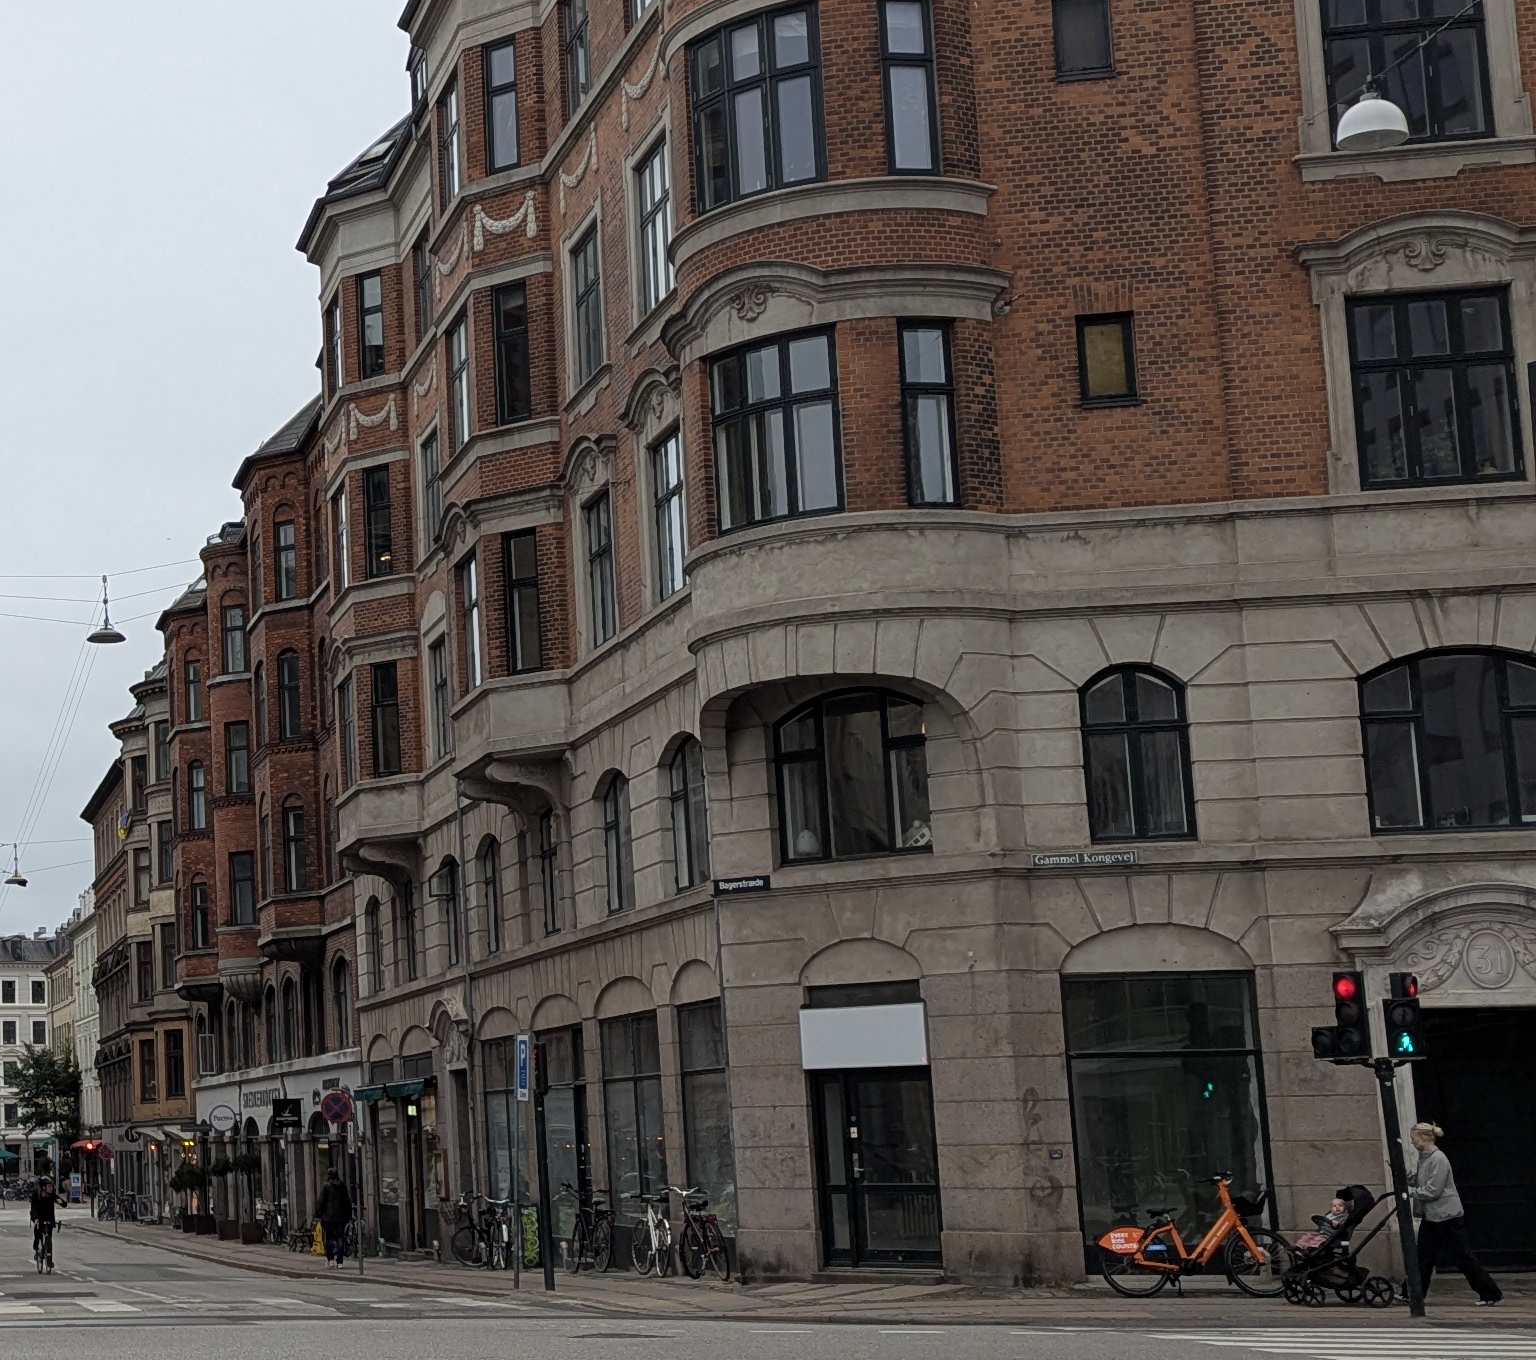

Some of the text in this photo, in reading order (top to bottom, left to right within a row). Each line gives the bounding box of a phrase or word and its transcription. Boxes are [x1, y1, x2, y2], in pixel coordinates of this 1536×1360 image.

[1035, 852, 1133, 864] Gammel Kongevej
[1474, 945, 1504, 975] 31
